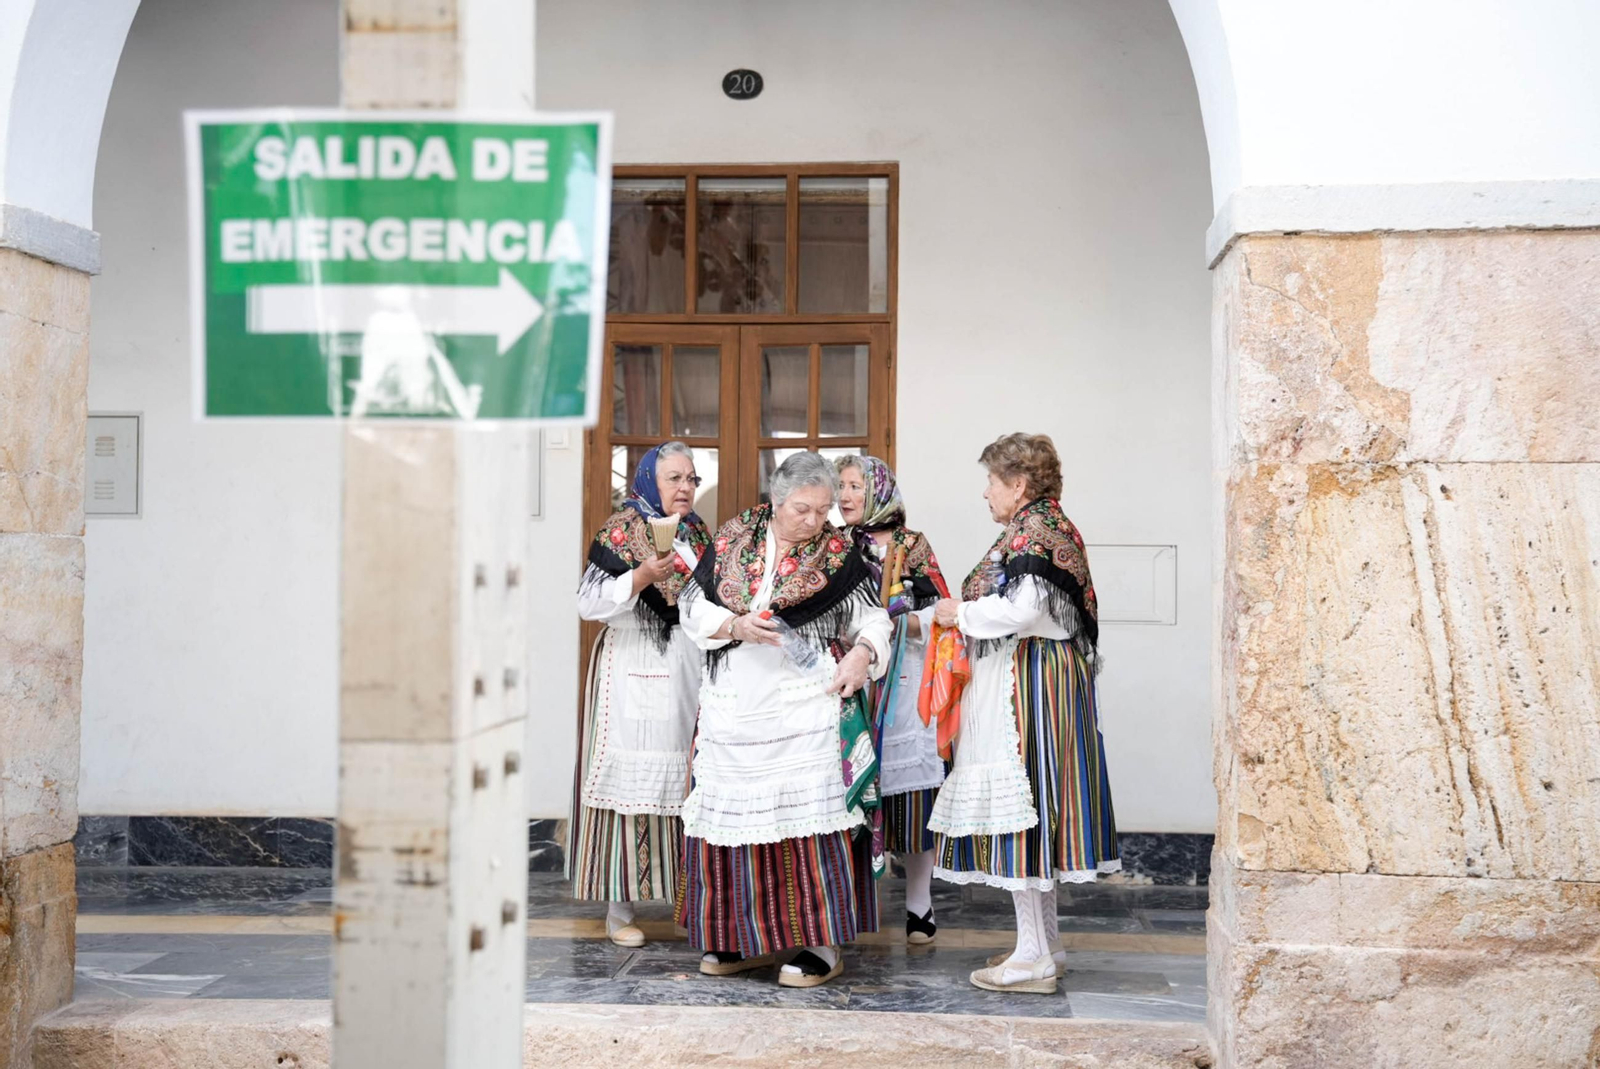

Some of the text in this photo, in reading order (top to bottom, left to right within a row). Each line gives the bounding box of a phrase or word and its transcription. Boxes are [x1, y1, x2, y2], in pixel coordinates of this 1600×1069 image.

[729, 74, 755, 94] 20
[254, 136, 549, 182] SALIDA DE
[221, 218, 582, 262] EMERGENCIA
